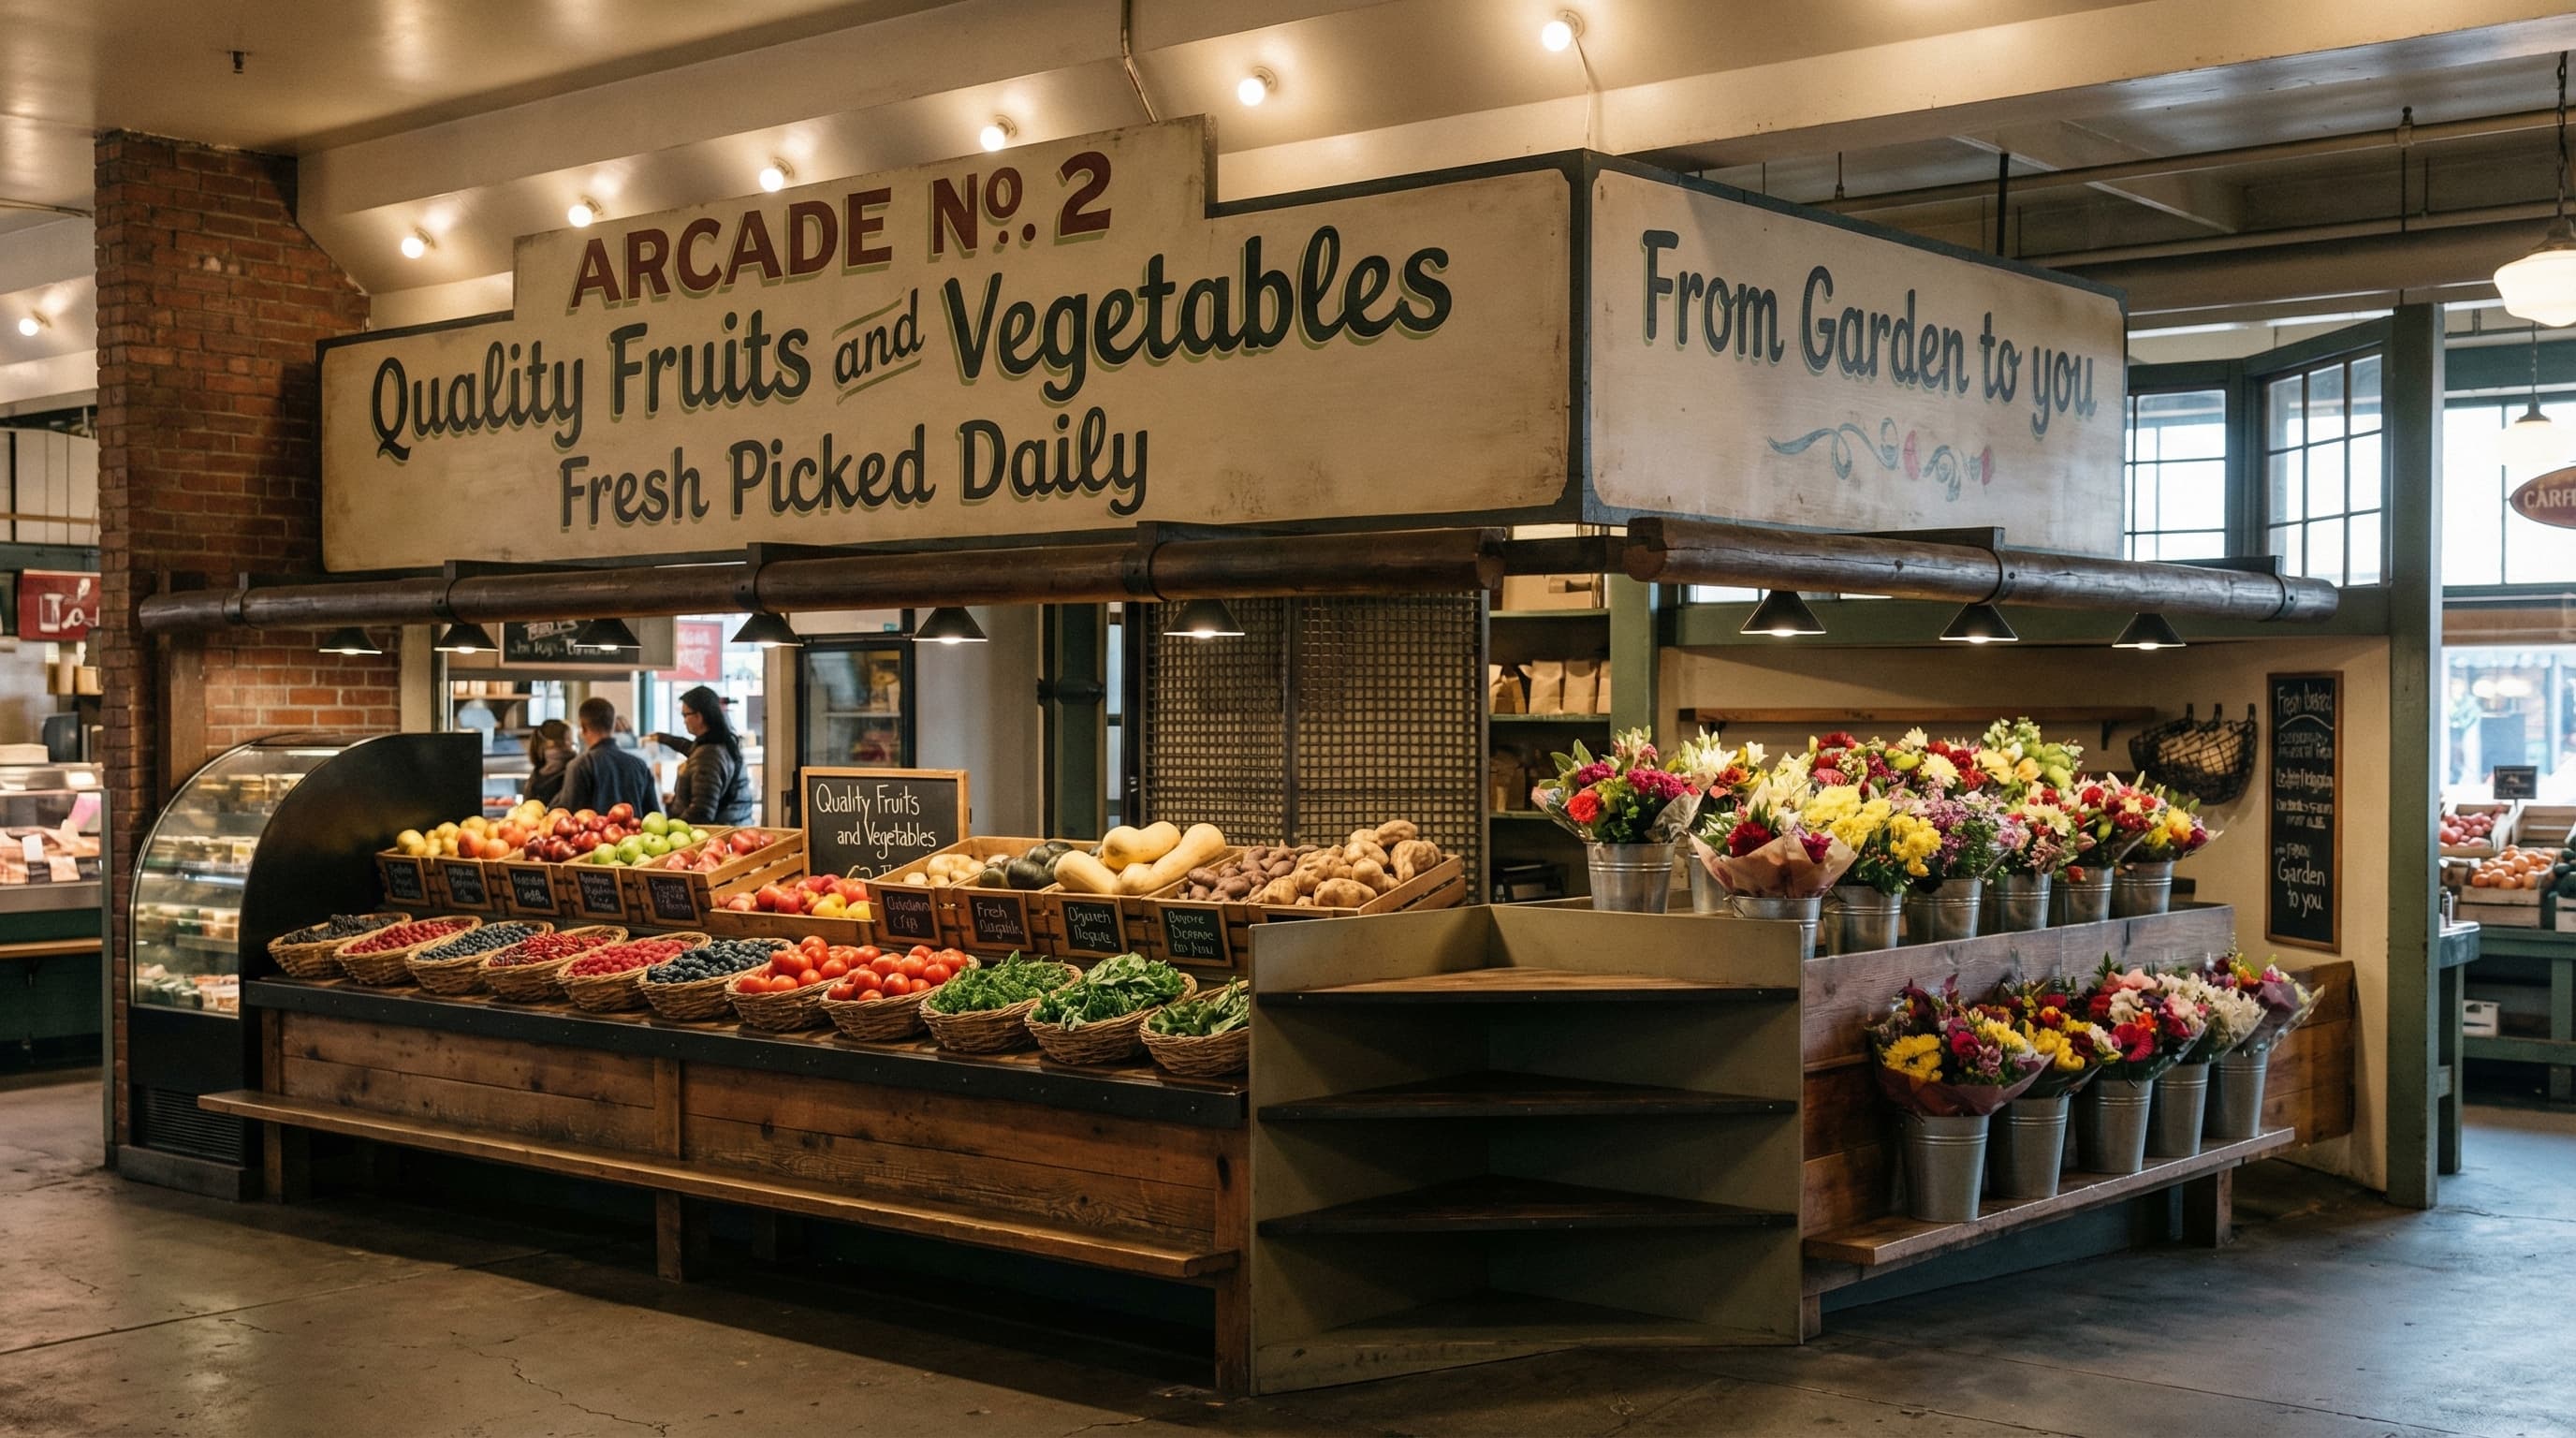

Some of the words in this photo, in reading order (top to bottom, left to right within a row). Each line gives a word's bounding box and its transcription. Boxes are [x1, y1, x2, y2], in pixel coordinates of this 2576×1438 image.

[566, 187, 892, 314] ARCADE
[1057, 151, 1111, 243] 2
[372, 339, 584, 461] Quality
[608, 310, 812, 418] Fruits
[835, 287, 925, 384] and
[941, 225, 1452, 402] Vegetables
[1641, 229, 1784, 365] From
[1800, 265, 1969, 395] Garden
[1980, 312, 2022, 403] to
[2031, 345, 2097, 439] you
[560, 447, 710, 531] Fresh
[729, 423, 935, 518] Picked
[959, 406, 1147, 517] Daily
[816, 783, 871, 824] Quality
[876, 785, 920, 815] Fruits
[837, 821, 861, 845] and
[864, 821, 936, 860] Vegetables
[2277, 857, 2325, 887] Garden
[2302, 892, 2323, 917] you
